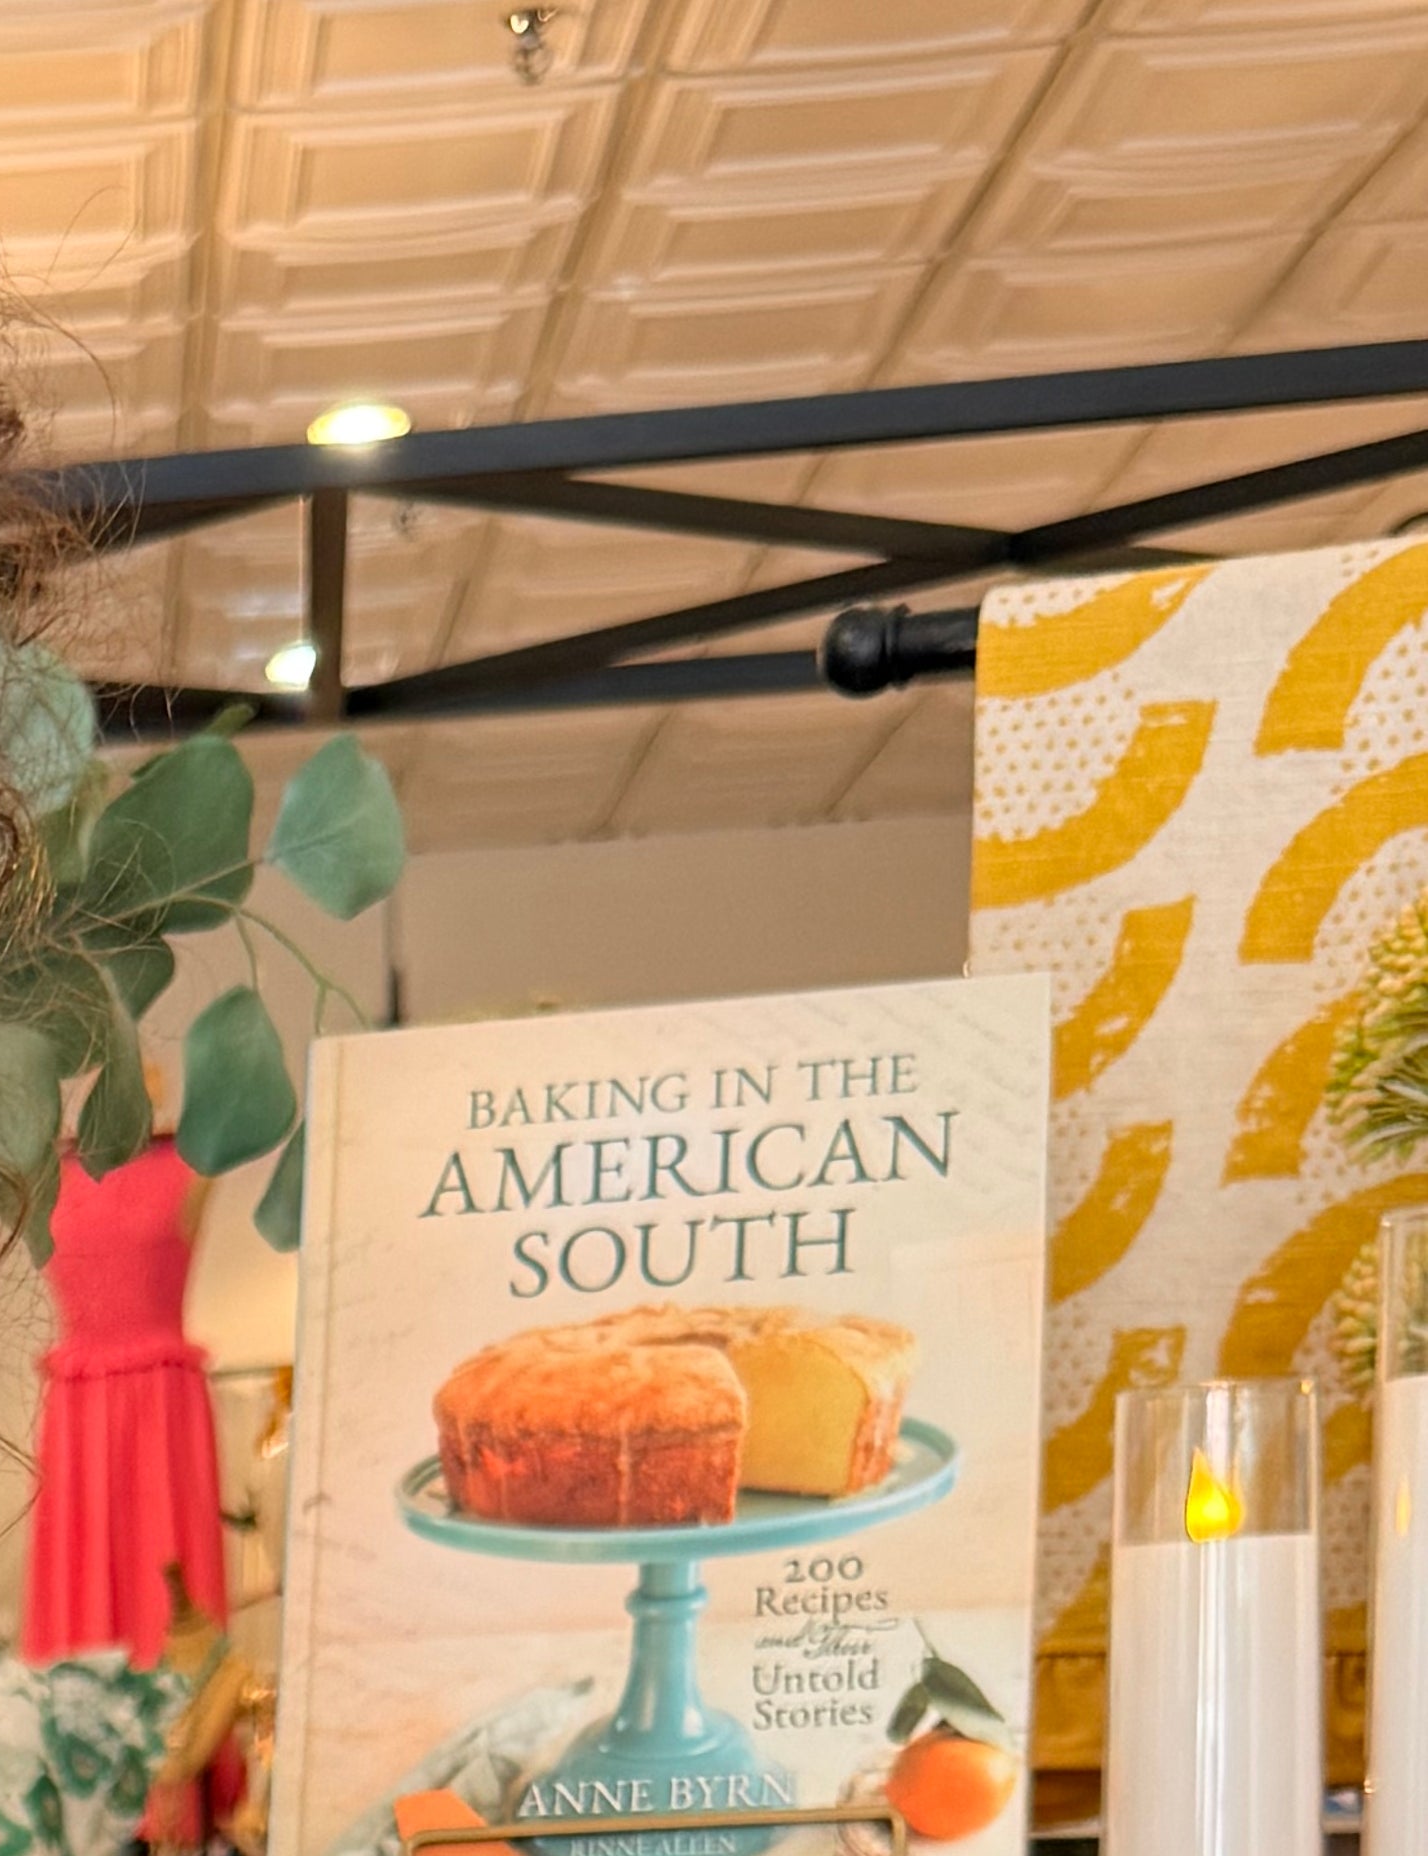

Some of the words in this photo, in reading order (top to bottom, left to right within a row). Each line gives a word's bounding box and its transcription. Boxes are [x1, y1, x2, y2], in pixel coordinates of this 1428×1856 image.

[466, 1072, 689, 1130] BAKING
[710, 1065, 778, 1110] IN
[796, 1053, 920, 1101] THE
[417, 1109, 960, 1219] AMERICAN
[508, 1207, 857, 1299] SOUTH
[784, 1555, 864, 1584] 200
[754, 1586, 889, 1626] Recipes
[752, 1657, 880, 1696] Untold
[752, 1698, 873, 1731] Stories
[517, 1778, 655, 1817] ANNE
[669, 1773, 797, 1811] BYRN
